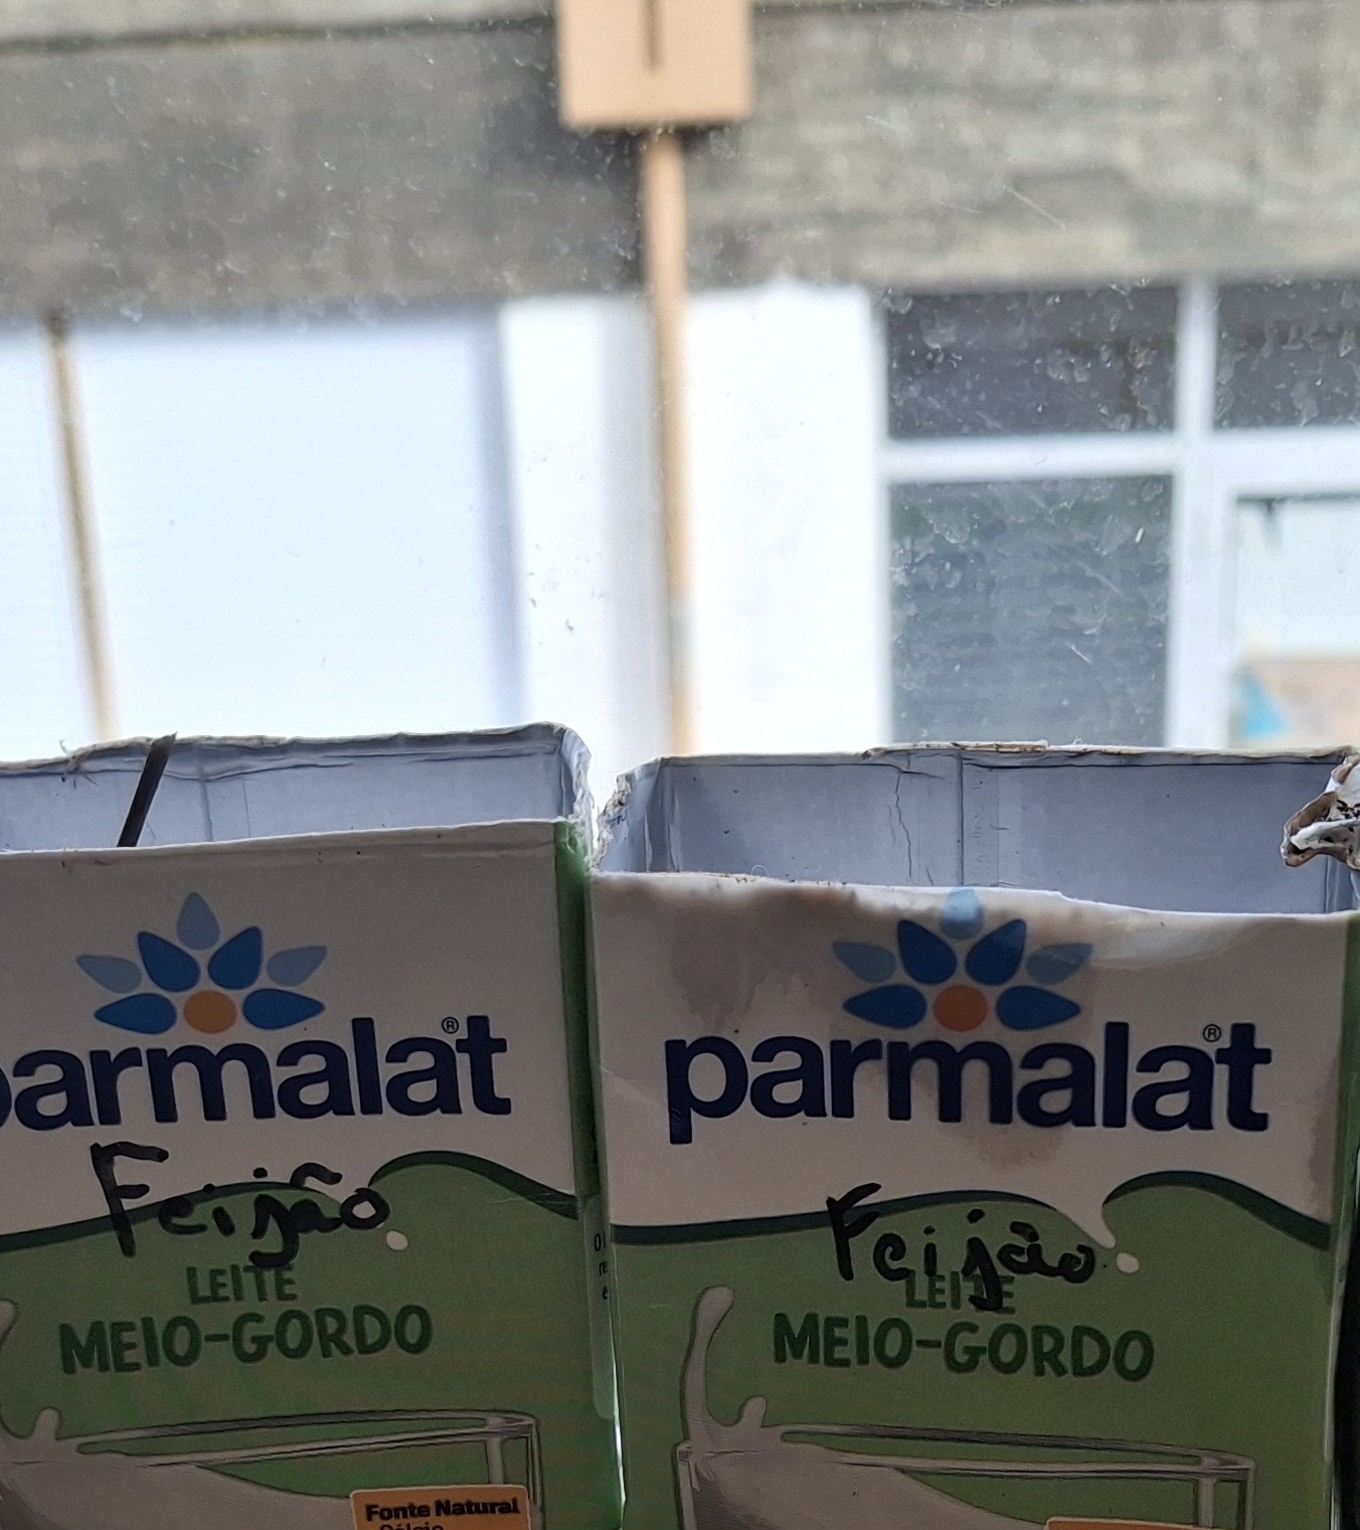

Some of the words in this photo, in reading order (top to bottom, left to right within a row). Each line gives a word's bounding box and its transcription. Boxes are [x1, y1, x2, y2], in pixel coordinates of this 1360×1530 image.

[665, 1022, 1273, 1145] parmalat
[186, 1262, 298, 1304] LEITE
[59, 1304, 433, 1374] MEIO-GORDO
[773, 1312, 1154, 1382] MEIO-GORDO
[365, 1503, 431, 1521] Fonte
[435, 1497, 520, 1517] Natural
